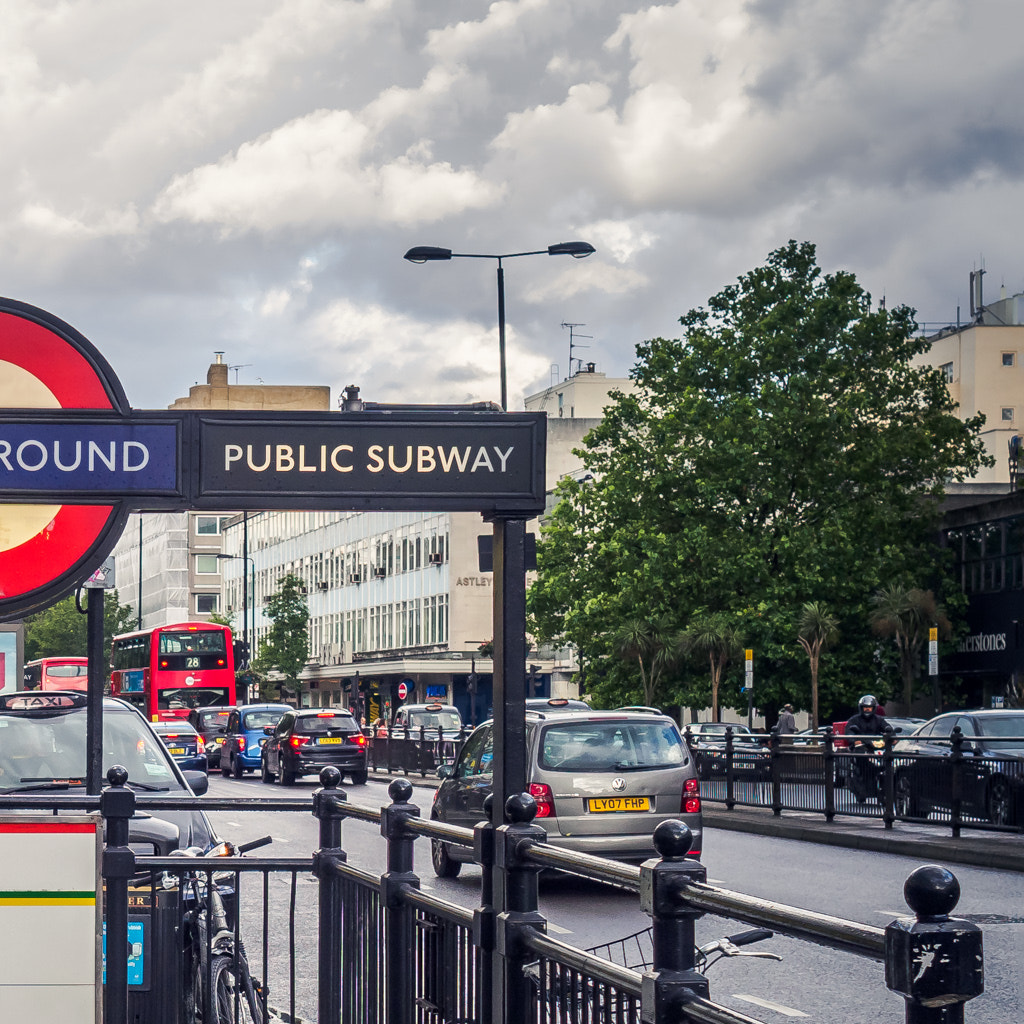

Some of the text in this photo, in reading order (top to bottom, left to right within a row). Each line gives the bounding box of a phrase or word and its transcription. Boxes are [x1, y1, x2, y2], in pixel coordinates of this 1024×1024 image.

[224, 444, 515, 473] PUBLIC SUBWAY
[456, 576, 493, 587] ASTLEY
[186, 657, 199, 668] 28
[20, 697, 62, 707] TAXI
[594, 799, 645, 810] LY07 FHP
